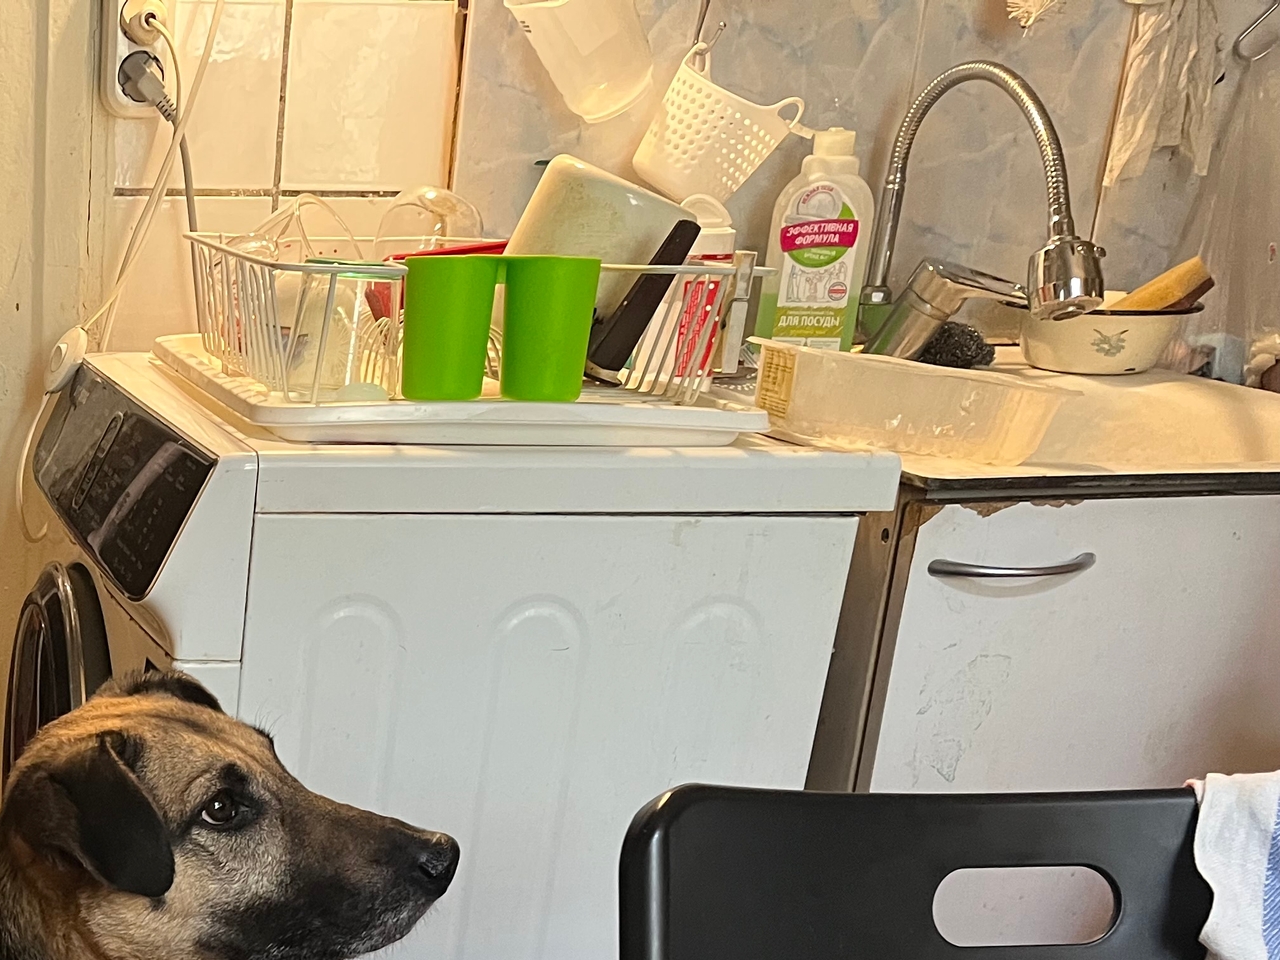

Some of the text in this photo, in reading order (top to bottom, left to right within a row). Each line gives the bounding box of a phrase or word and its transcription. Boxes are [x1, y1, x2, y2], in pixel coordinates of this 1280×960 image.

[786, 223, 854, 237] ЭФФЕКТИВНАЯ
[795, 233, 840, 245] ФОРМУЛА
[778, 315, 840, 328] ДЛЯ ПОСУДЫ
